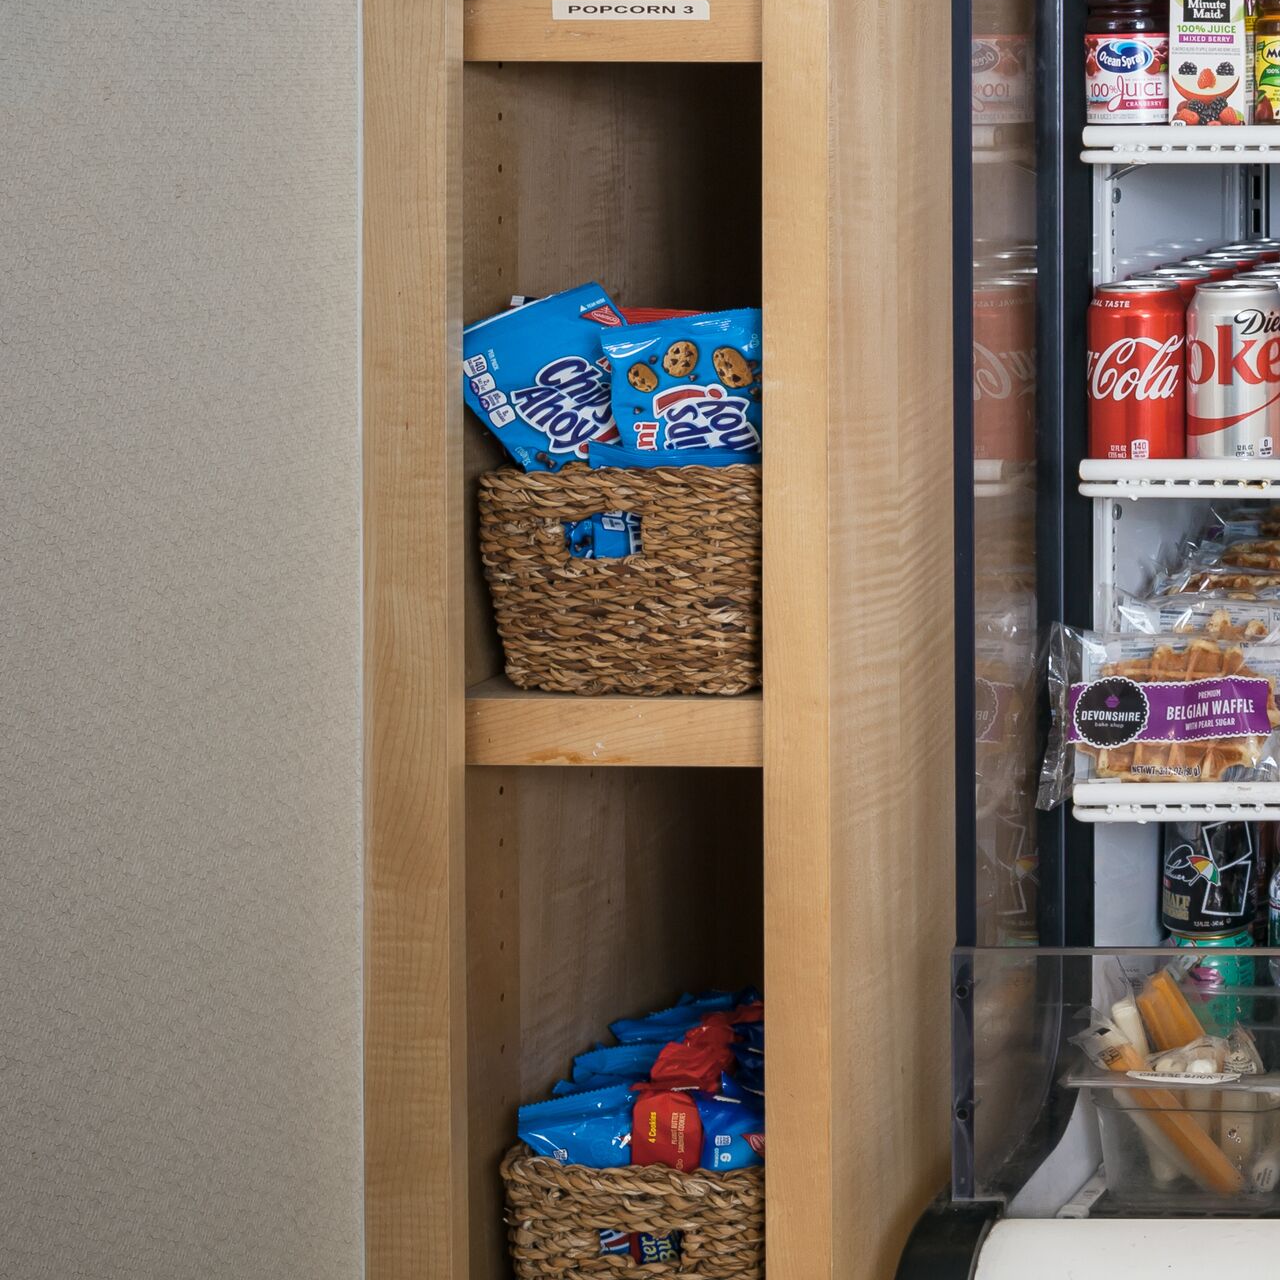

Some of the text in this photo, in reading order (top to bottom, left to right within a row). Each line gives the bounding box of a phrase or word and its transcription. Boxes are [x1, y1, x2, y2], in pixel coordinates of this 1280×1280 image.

[568, 5, 694, 14] POPCORN 3
[1188, 0, 1226, 10] Minute
[1177, 24, 1236, 34] 100% JUICE
[1183, 35, 1231, 43] MIXED BERRY
[1125, 100, 1162, 108] CRANBERRY
[1105, 300, 1130, 308] TASTE
[1091, 334, 1185, 402] Cola
[511, 385, 601, 448] Ahoy
[1198, 689, 1221, 699] PREMIUM
[1166, 698, 1255, 721] BELGIAN WAFFLE
[1081, 710, 1141, 722] DEVONSHIRE
[1185, 717, 1236, 731] WITH PEARL SUGAR
[648, 1112, 657, 1143] 4 Cookies
